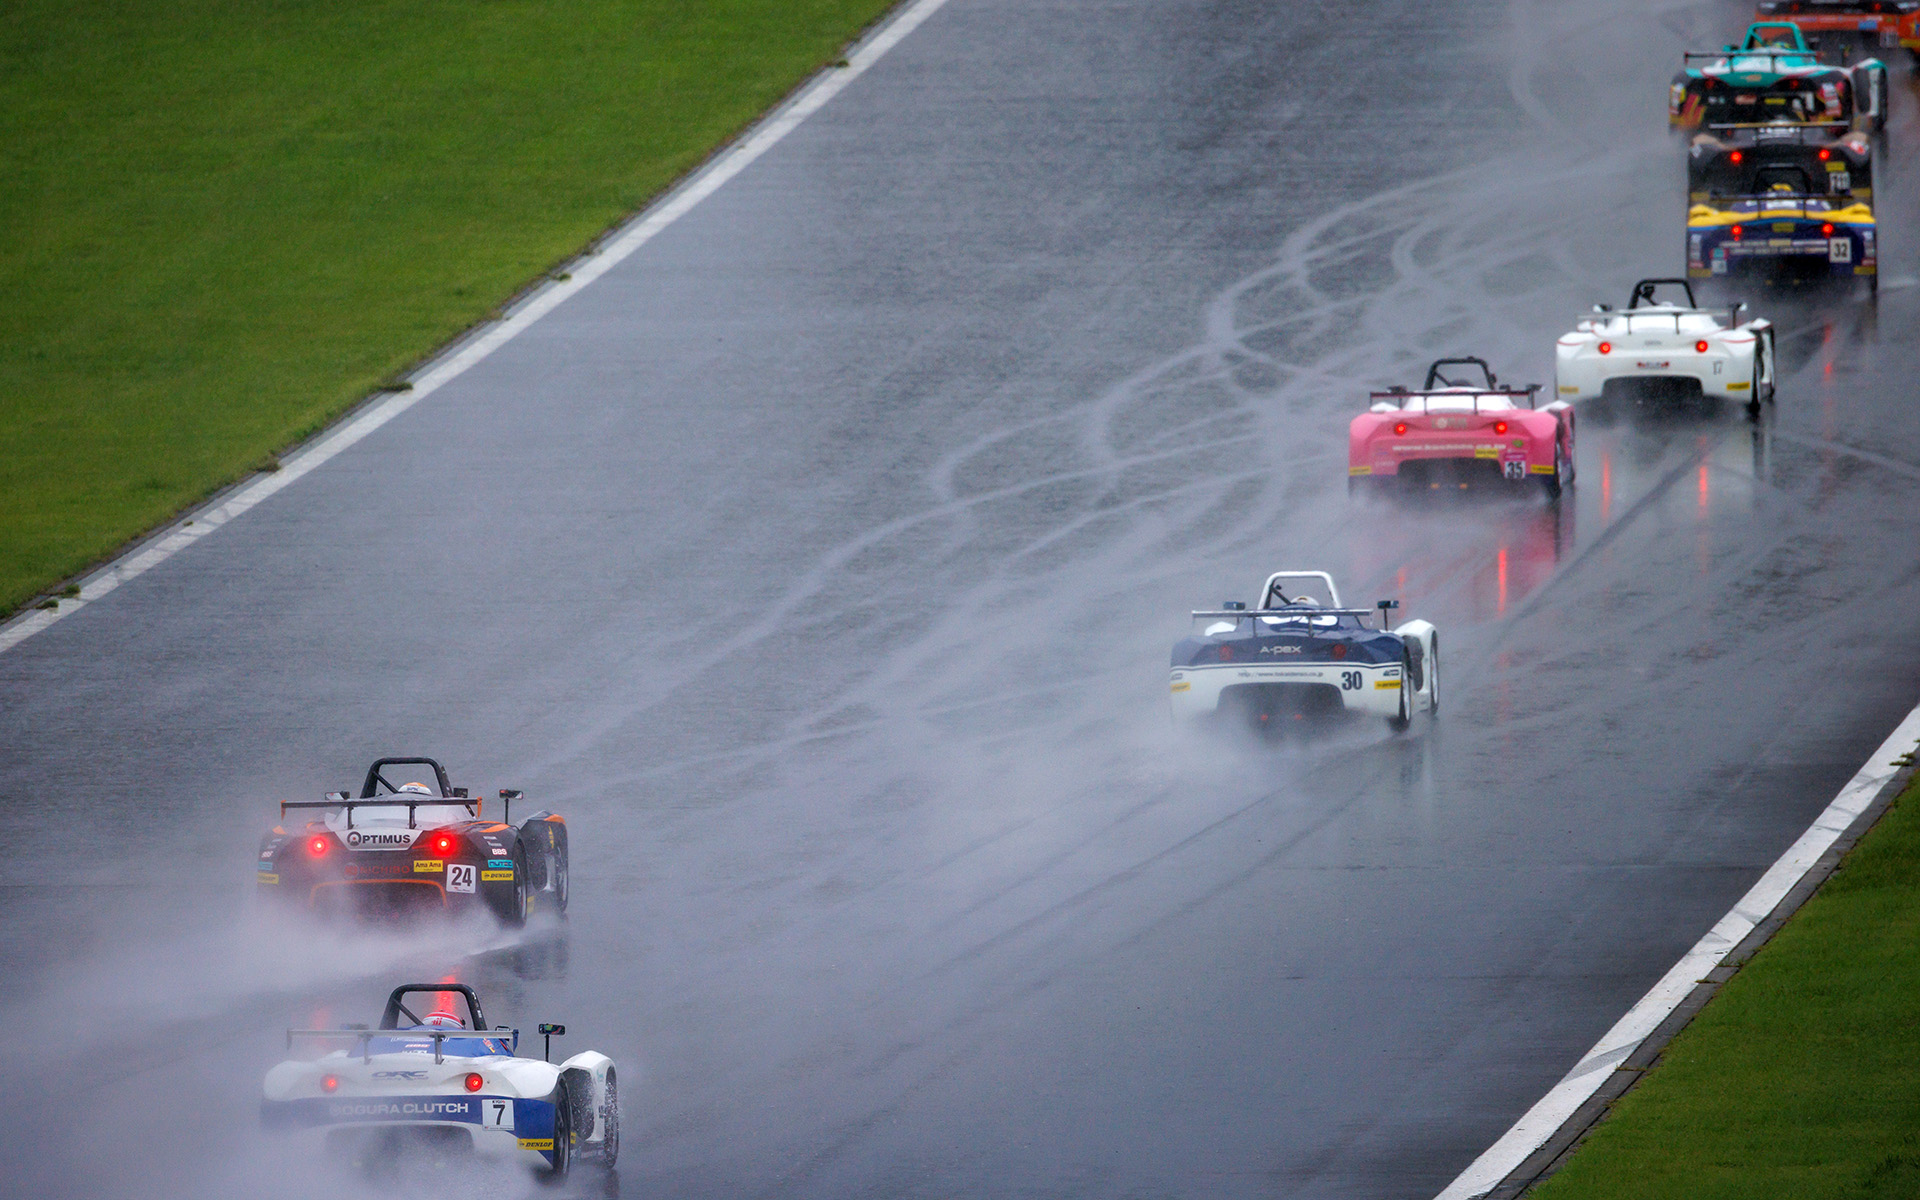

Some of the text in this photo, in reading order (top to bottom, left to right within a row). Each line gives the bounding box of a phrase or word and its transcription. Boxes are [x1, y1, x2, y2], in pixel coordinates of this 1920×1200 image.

[1834, 242, 1848, 258] 32
[1713, 360, 1723, 375] 17
[1507, 462, 1523, 479] 35
[1341, 671, 1362, 690] 30
[347, 831, 411, 846] OPTIMUS
[360, 864, 410, 875] NICHIBO
[451, 866, 472, 887] 24
[402, 1102, 469, 1114] CLUTCH
[493, 1104, 506, 1126] 7
